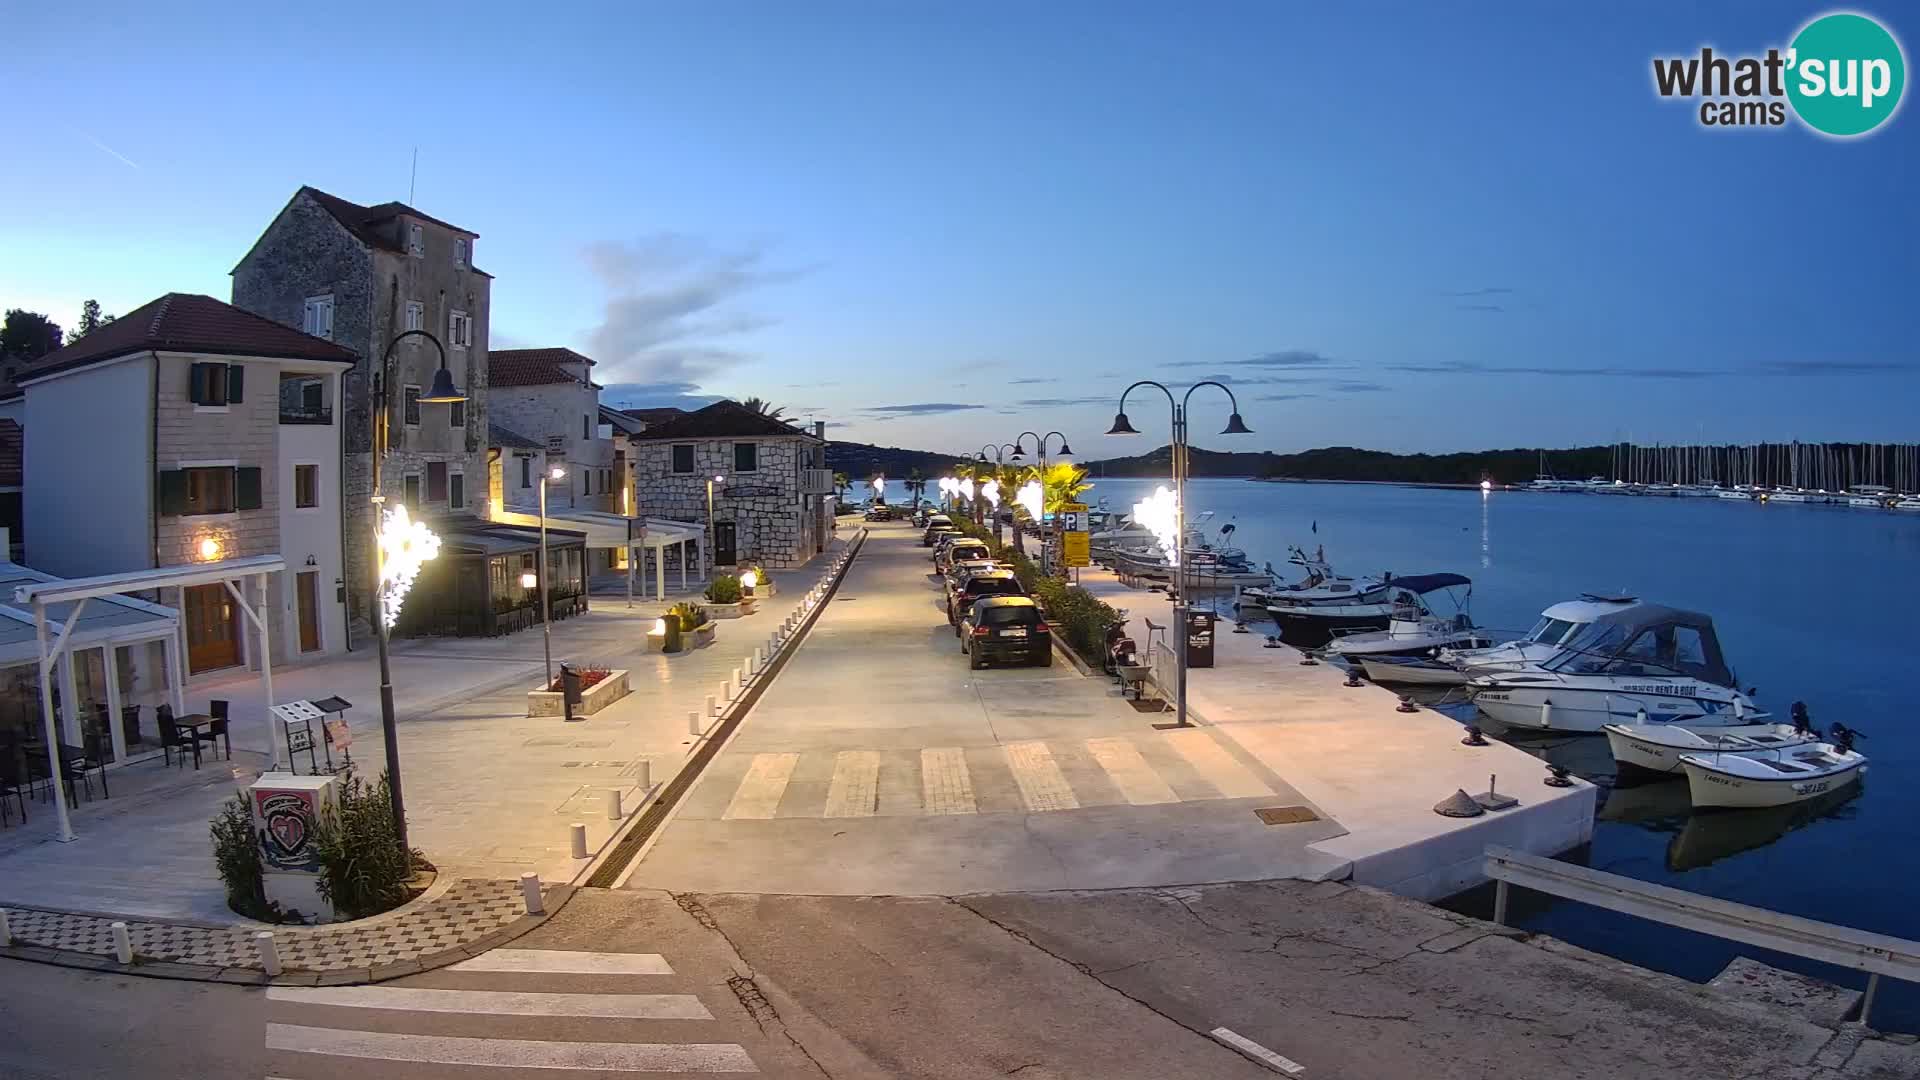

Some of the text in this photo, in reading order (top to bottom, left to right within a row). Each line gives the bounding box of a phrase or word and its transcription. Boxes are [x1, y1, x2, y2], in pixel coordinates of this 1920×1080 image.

[1065, 513, 1075, 530] P
[1655, 686, 1674, 695] RENT
[1679, 686, 1697, 697] BOAT
